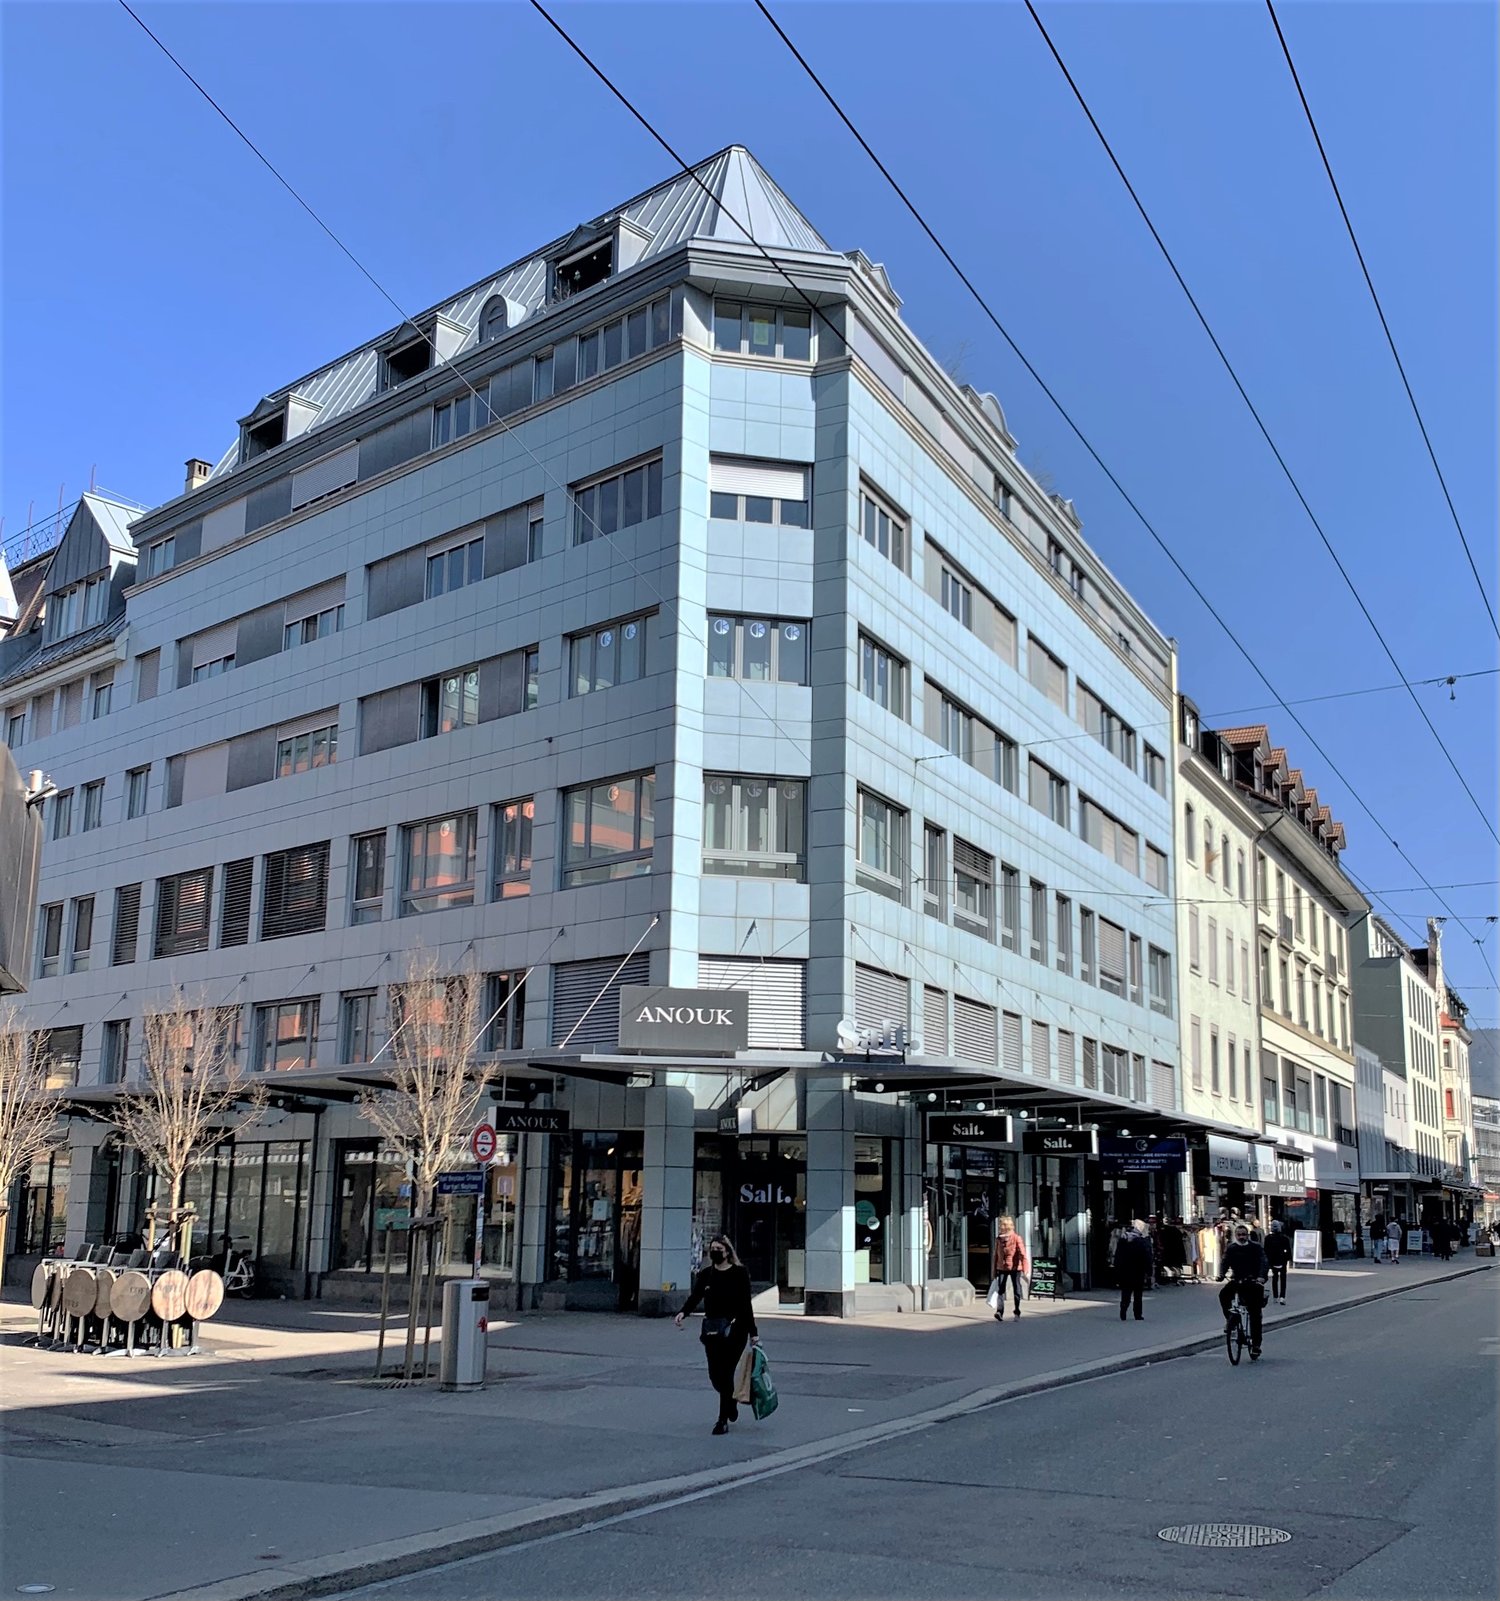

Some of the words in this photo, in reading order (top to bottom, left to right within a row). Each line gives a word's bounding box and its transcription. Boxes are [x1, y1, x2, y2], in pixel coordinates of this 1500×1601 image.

[636, 1006, 734, 1025] ANOUK
[837, 1019, 921, 1051] Salt.
[506, 1115, 559, 1129] ANOUK
[952, 1122, 985, 1136] Salt.
[1043, 1136, 1073, 1149] Salt.
[740, 1183, 792, 1203] Salt.
